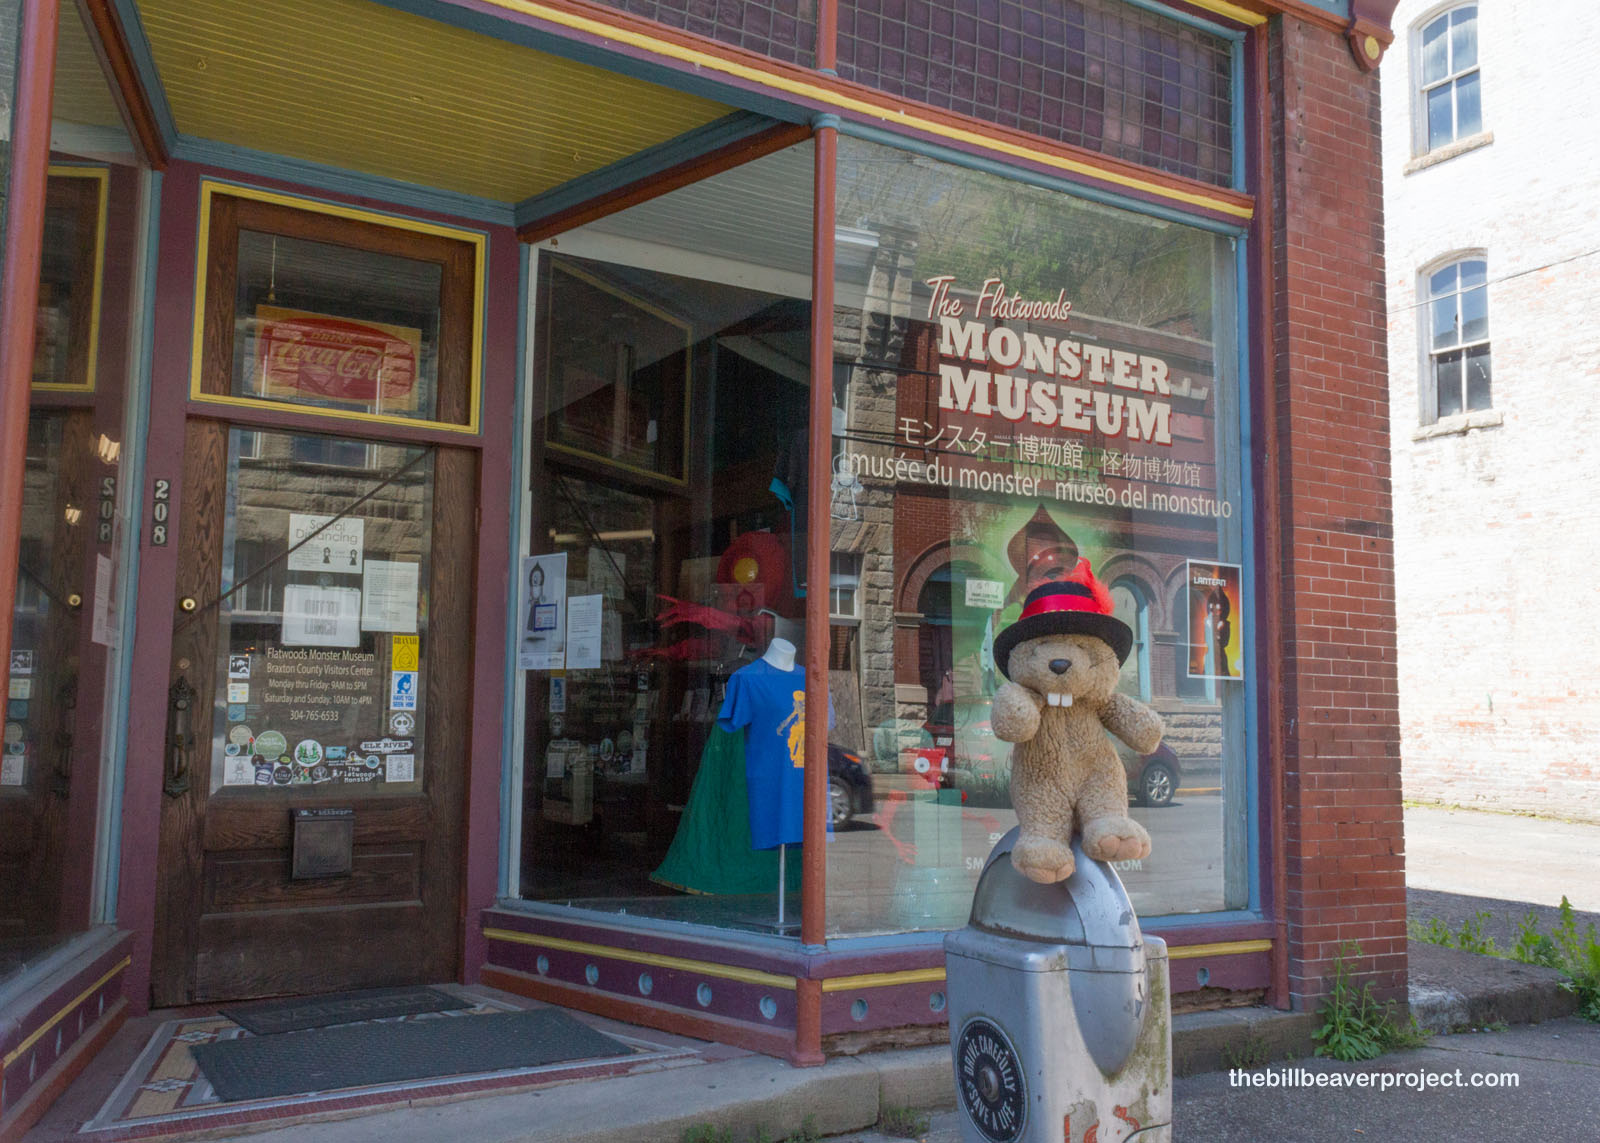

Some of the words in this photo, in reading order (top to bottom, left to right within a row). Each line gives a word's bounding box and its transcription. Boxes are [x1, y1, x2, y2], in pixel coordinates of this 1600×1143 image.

[926, 275, 964, 319] The
[975, 277, 1073, 321] Flatwoods
[939, 316, 1171, 396] MONSTER
[938, 364, 1172, 446] MUSEUM
[898, 416, 1011, 452] モンスター
[1017, 432, 1084, 470] 博物館
[849, 450, 919, 482] musée
[925, 457, 954, 487] du
[959, 468, 1040, 497] monster
[1055, 482, 1117, 506] museo
[1121, 482, 1148, 510] del
[1153, 492, 1232, 518] monstruo
[1101, 449, 1202, 488] 怪物博物馆
[153, 480, 169, 545] 208
[295, 528, 358, 546] Diancing
[1193, 576, 1226, 587] LANTERN
[266, 648, 307, 660] Flatwoods
[309, 649, 341, 661] Monster
[342, 650, 375, 662] Museum
[266, 663, 296, 673] Braxton
[296, 664, 323, 676] County
[324, 664, 350, 676] Visitors
[350, 665, 375, 676] Center
[264, 693, 293, 705] Saturday
[293, 694, 306, 704] and
[333, 695, 351, 704] 10AM
[351, 696, 358, 704] to
[358, 696, 373, 704] 4PM
[268, 679, 294, 690] Monday
[296, 679, 309, 689] thru
[331, 681, 346, 690] 9AM
[290, 710, 340, 720] 304-765-6533
[963, 1038, 980, 1077] DRIVE
[978, 1034, 1017, 1093] CAREFULLY
[968, 1088, 990, 1125] SAVE
[991, 1111, 999, 1131] A
[997, 1101, 1016, 1130] LIFE
